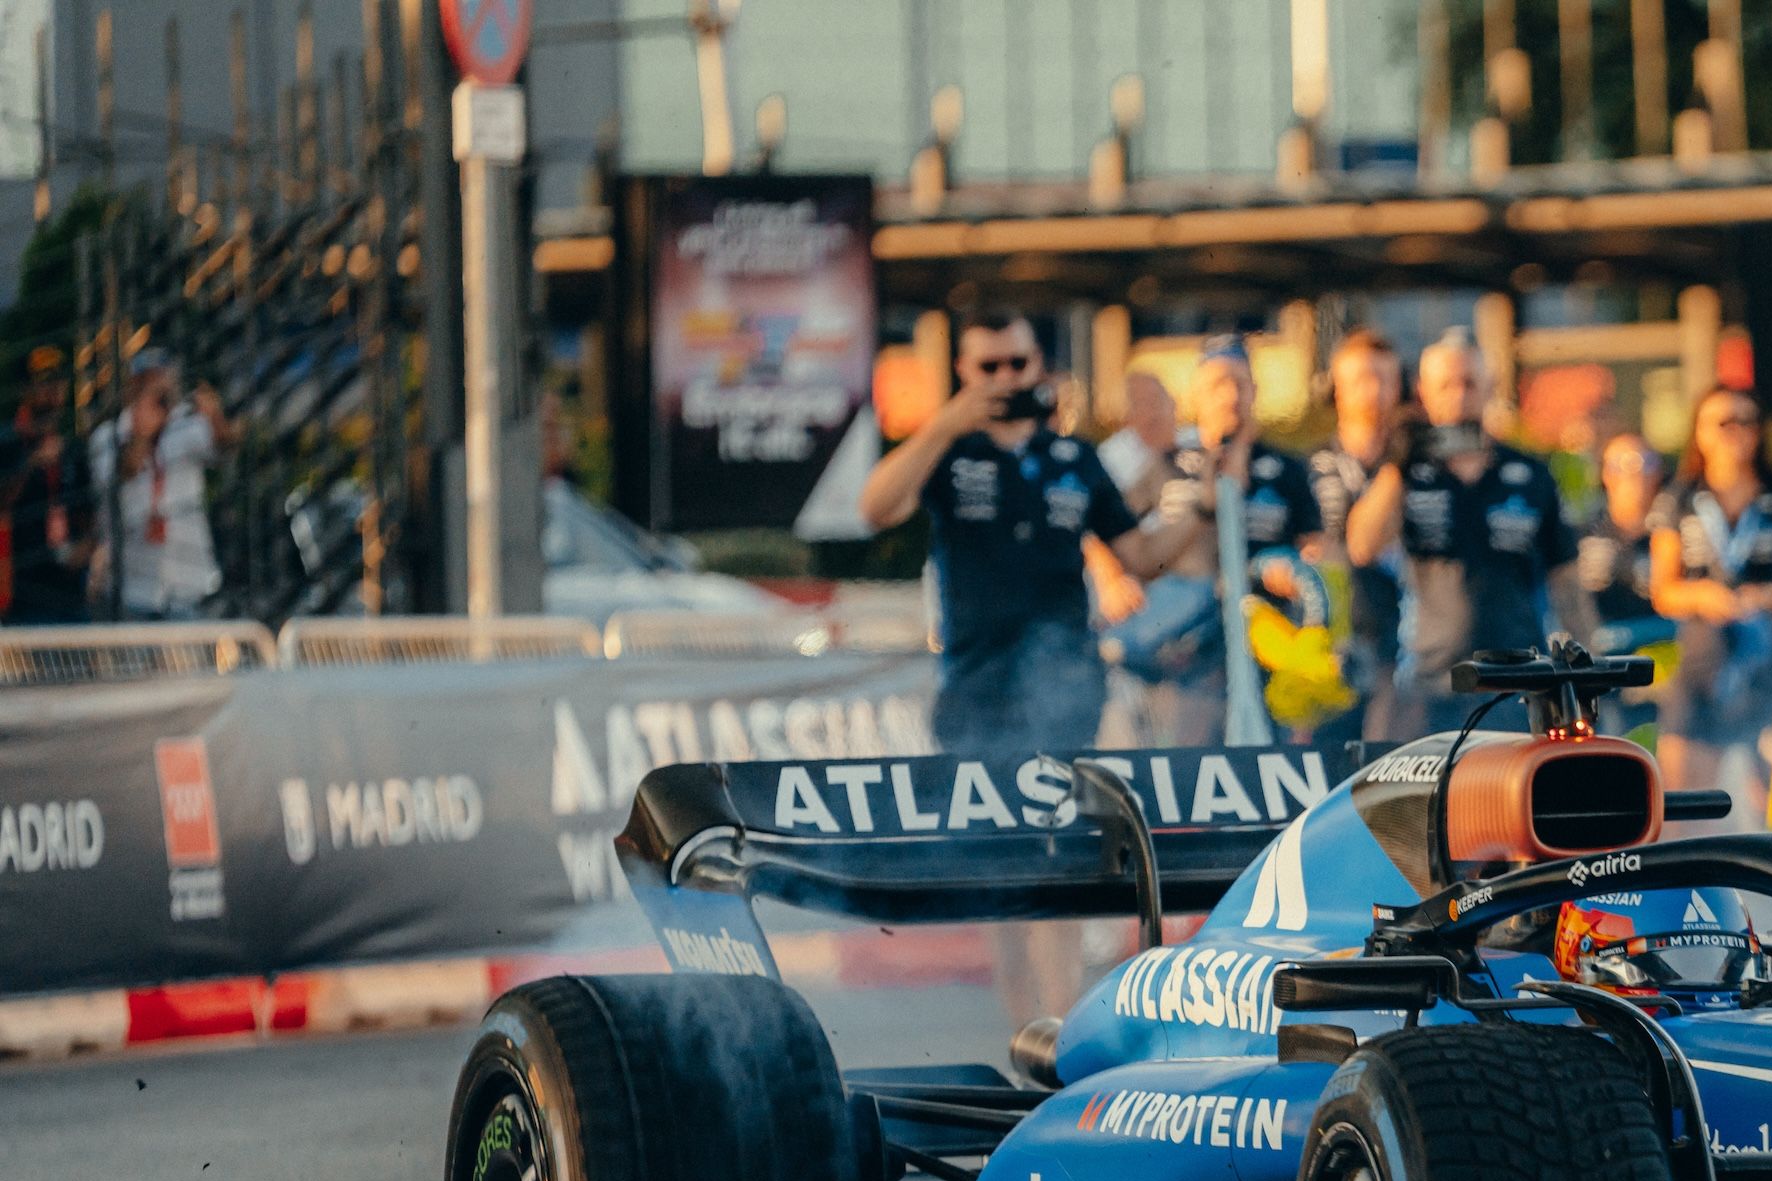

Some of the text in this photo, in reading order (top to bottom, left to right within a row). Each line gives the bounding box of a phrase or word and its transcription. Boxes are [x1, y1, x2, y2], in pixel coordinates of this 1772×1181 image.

[1367, 756, 1447, 783] DURACELL
[774, 751, 1328, 833] ATLASIAN
[327, 774, 483, 850] MADRID
[1591, 852, 1641, 877] airia
[1457, 886, 1493, 914] KEEPER
[1683, 922, 1721, 931] ATLASSIAN
[662, 927, 769, 977] KOMATSU
[1670, 934, 1746, 949] MYPROTEIN
[1100, 1089, 1288, 1151] MYPROTEIN
